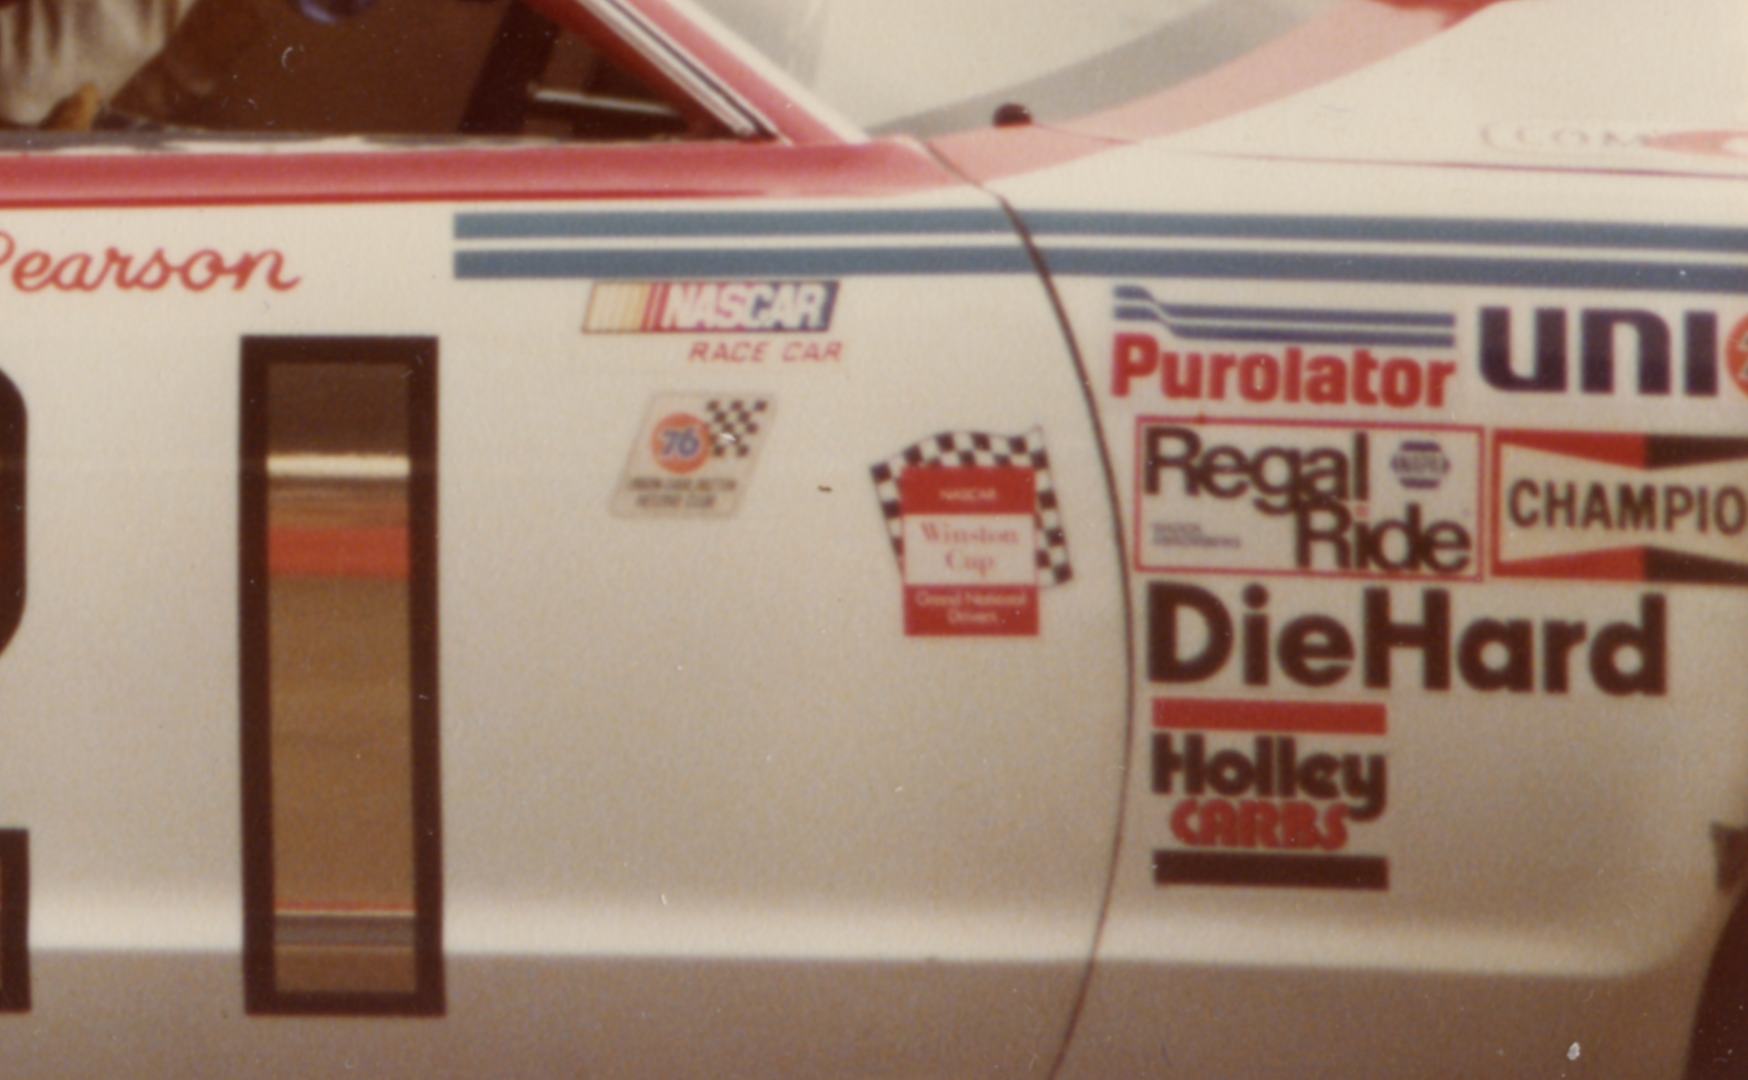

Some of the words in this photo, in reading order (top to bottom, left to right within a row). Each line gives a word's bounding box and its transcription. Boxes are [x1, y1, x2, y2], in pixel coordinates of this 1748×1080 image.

[658, 281, 830, 332] NASCAR
[688, 341, 769, 363] RACE
[781, 341, 843, 363] CAR
[1111, 332, 1456, 408] Purolator
[661, 427, 701, 458] 76
[1144, 425, 1370, 516] Regal
[920, 521, 1020, 545] Winston
[1294, 500, 1473, 573] Ride
[944, 548, 995, 580] Cup
[1147, 581, 1668, 696] DieHard
[1151, 732, 1387, 822] Holley
[1169, 798, 1349, 850] CARBS
